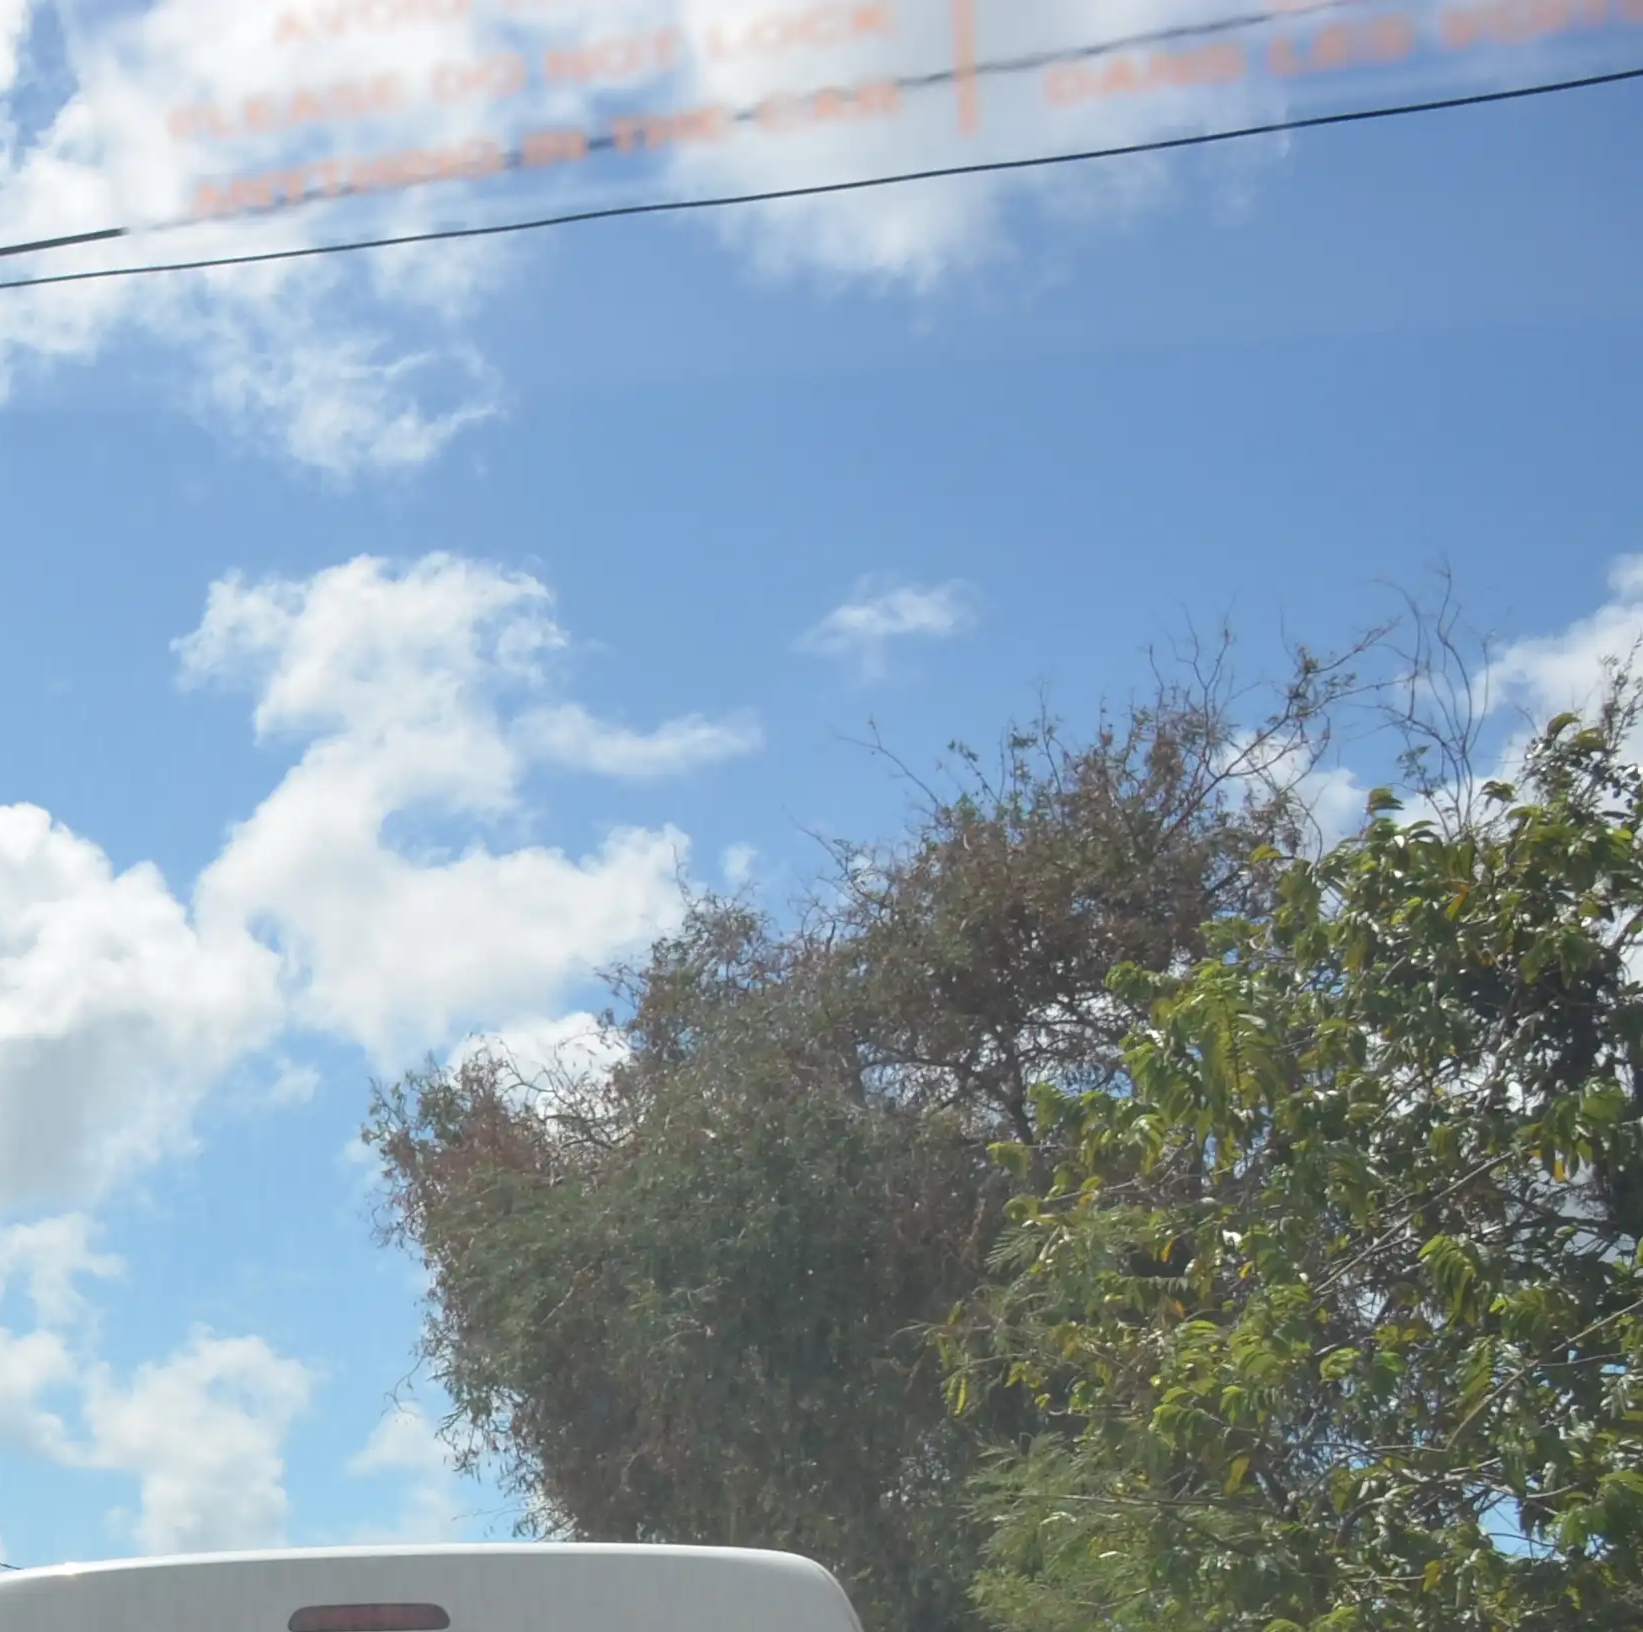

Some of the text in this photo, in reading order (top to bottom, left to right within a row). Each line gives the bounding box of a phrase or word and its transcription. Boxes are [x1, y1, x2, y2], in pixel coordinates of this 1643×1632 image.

[430, 50, 527, 104] DO
[543, 26, 681, 86] NOT
[521, 128, 587, 168] IN
[608, 106, 727, 152] THE
[755, 80, 905, 134] CAR
